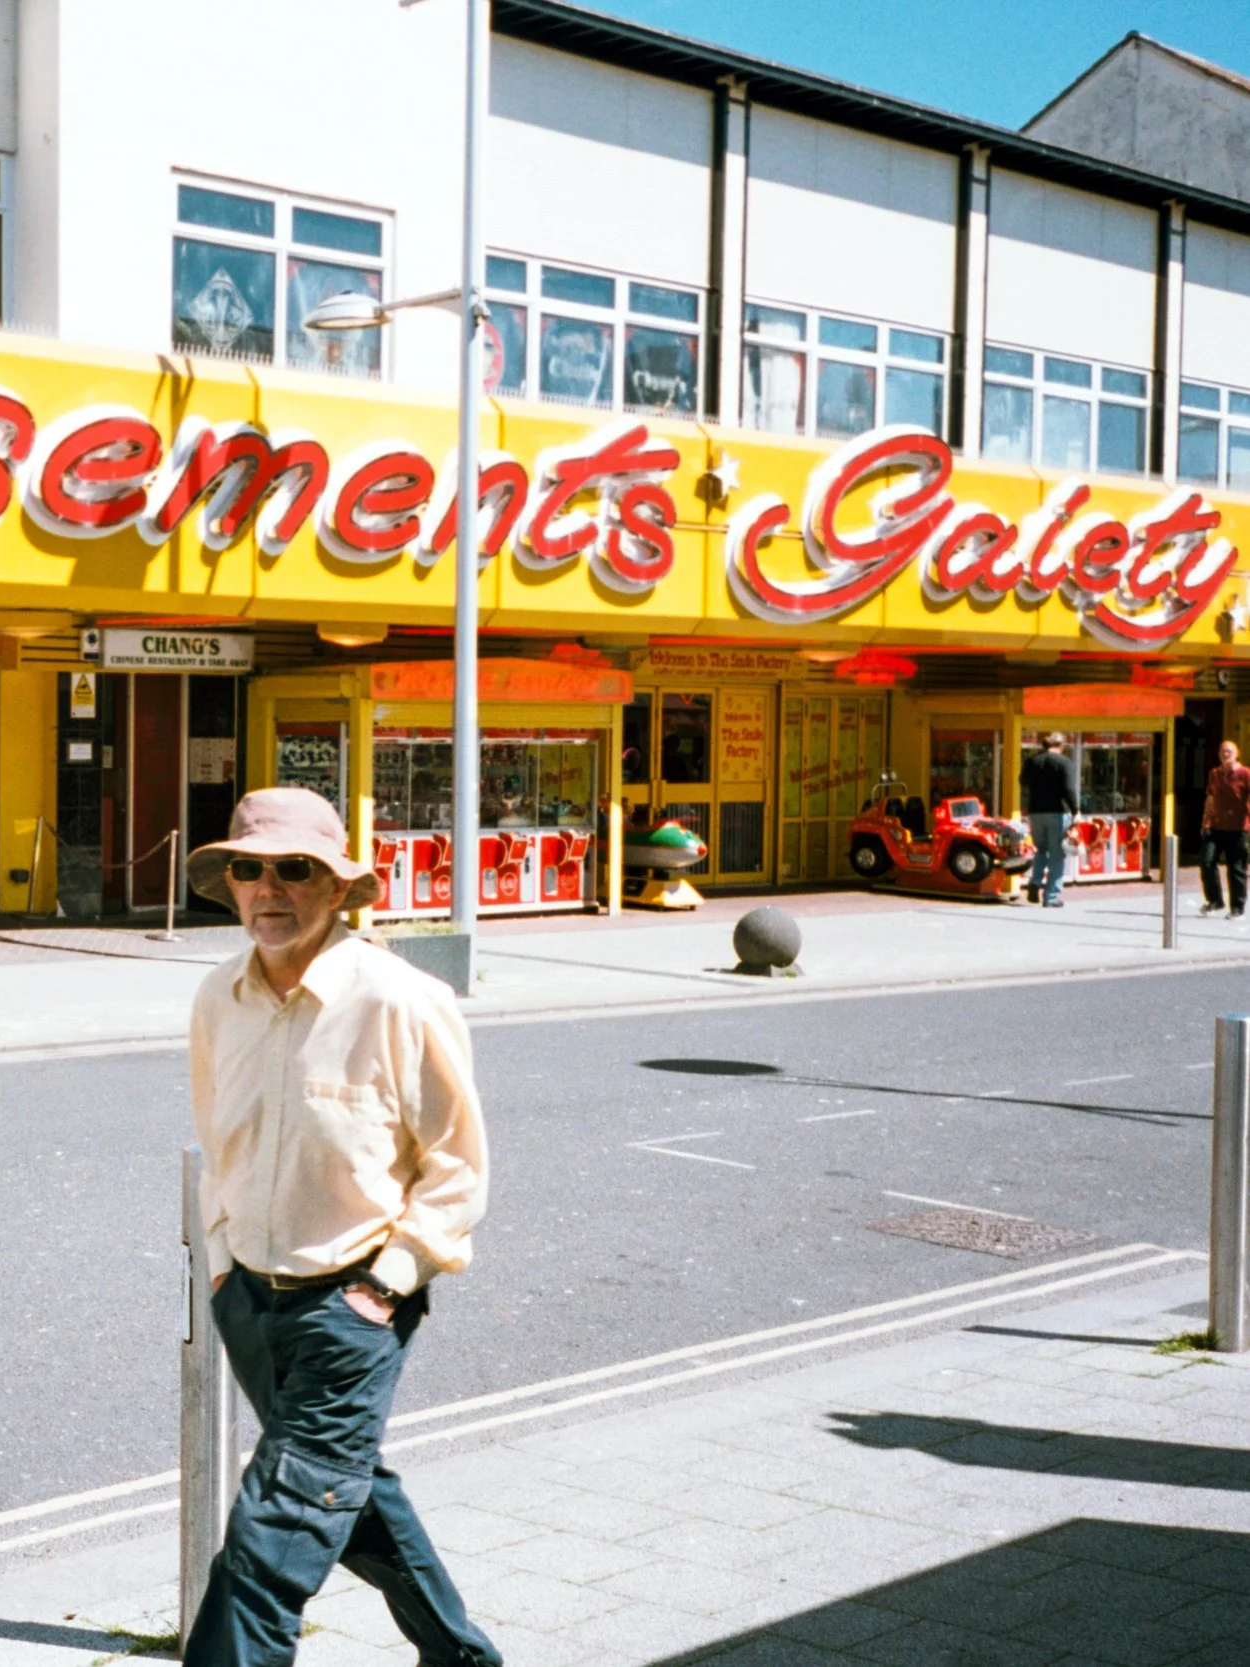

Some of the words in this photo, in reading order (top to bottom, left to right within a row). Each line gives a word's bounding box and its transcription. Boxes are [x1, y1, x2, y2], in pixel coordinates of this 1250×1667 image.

[726, 424, 1238, 650] Gaiety
[141, 635, 220, 656] CHANG'S
[110, 655, 145, 665] CHINESE
[148, 657, 197, 666] RESTAURANT
[208, 659, 227, 667] TAKE
[229, 659, 249, 668] AWAY
